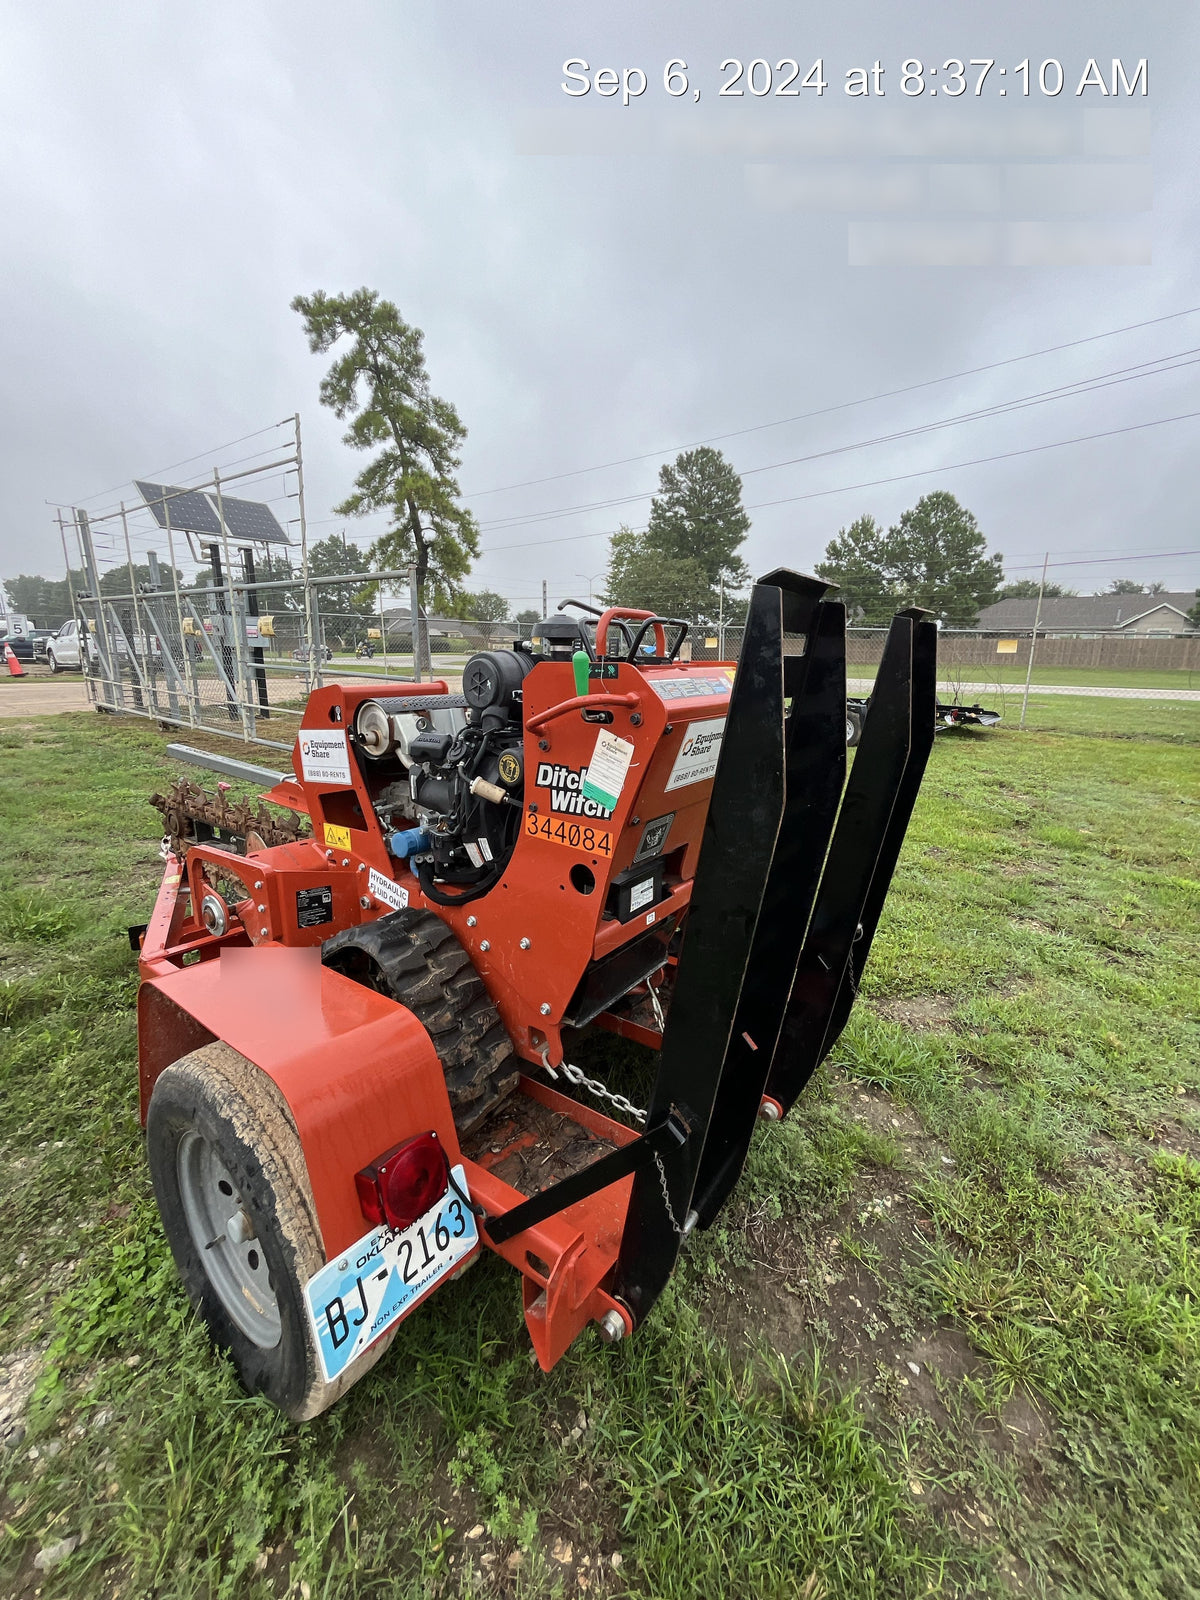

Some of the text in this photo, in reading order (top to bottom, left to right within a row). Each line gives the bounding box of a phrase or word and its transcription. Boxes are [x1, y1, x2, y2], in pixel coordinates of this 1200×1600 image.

[13, 624, 23, 635] 5
[310, 740, 345, 750] Equipment
[691, 745, 711, 756] Share
[311, 750, 330, 758] Share
[527, 813, 611, 856] 344084
[370, 871, 407, 900] HYDRAULIC
[370, 883, 388, 899] FLUID
[371, 1262, 444, 1332] NON EXP TRAILER
